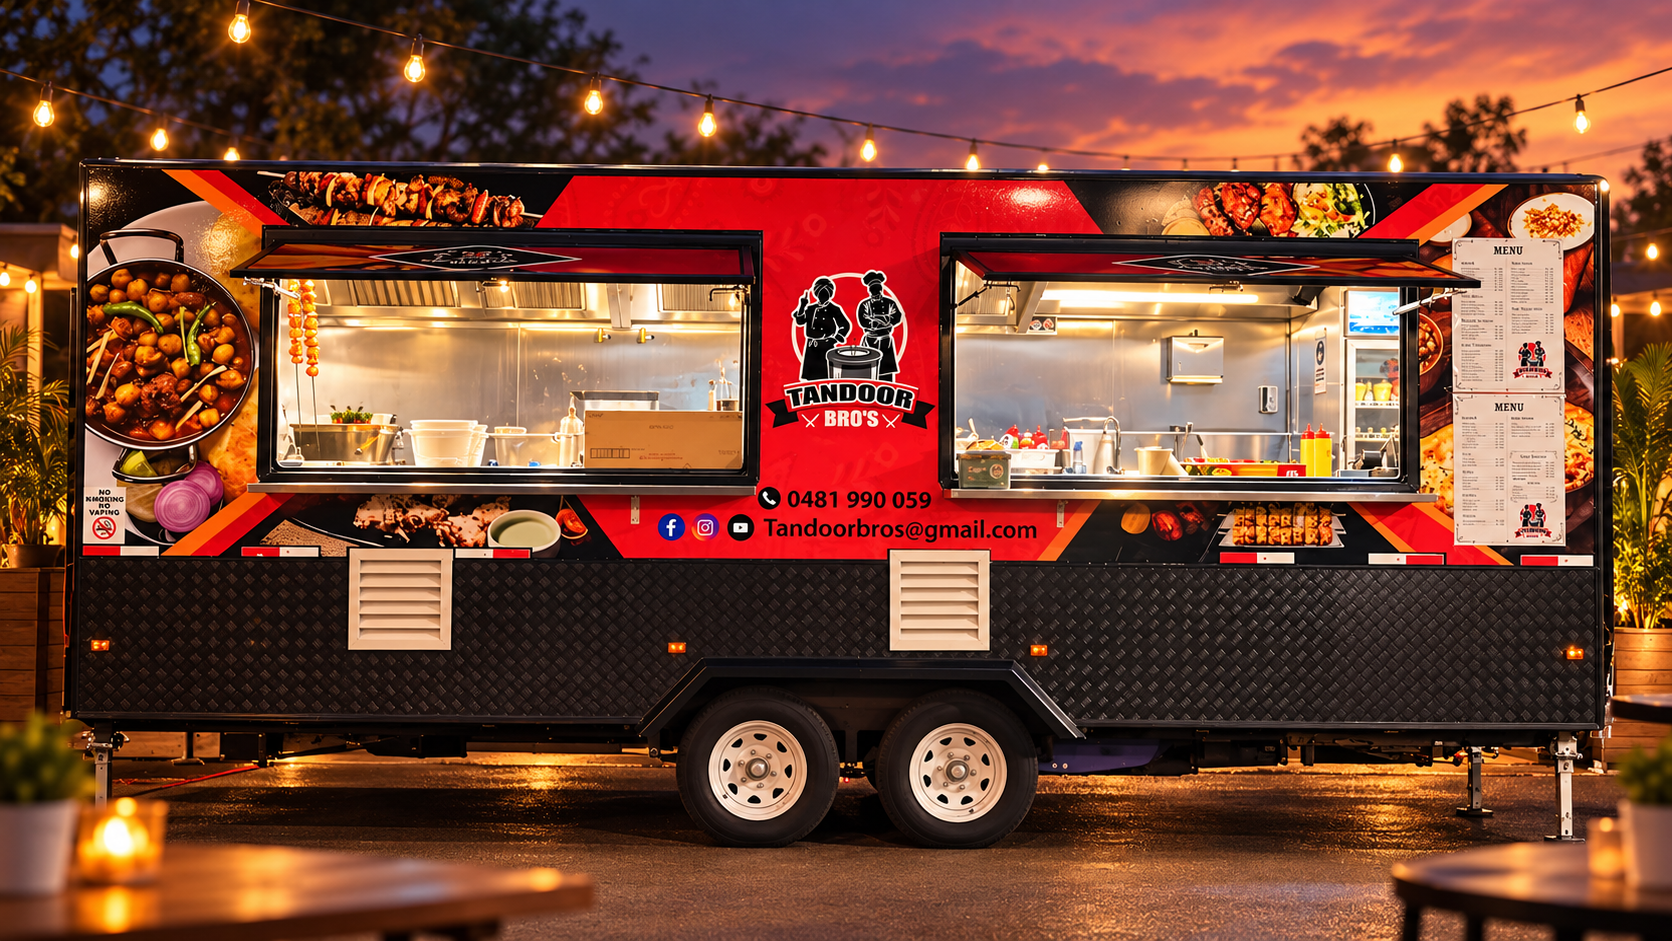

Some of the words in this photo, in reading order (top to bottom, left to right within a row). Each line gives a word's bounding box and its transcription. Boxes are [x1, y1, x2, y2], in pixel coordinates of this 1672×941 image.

[1493, 246, 1524, 255] MENU
[785, 383, 915, 411] TANDOOR
[1494, 402, 1525, 412] MENU
[824, 410, 879, 427] BRO'S
[787, 490, 838, 508] 0481
[846, 491, 886, 508] 990
[892, 491, 932, 509] 059
[763, 517, 1037, 543] Tandoorbros@gmail.com
